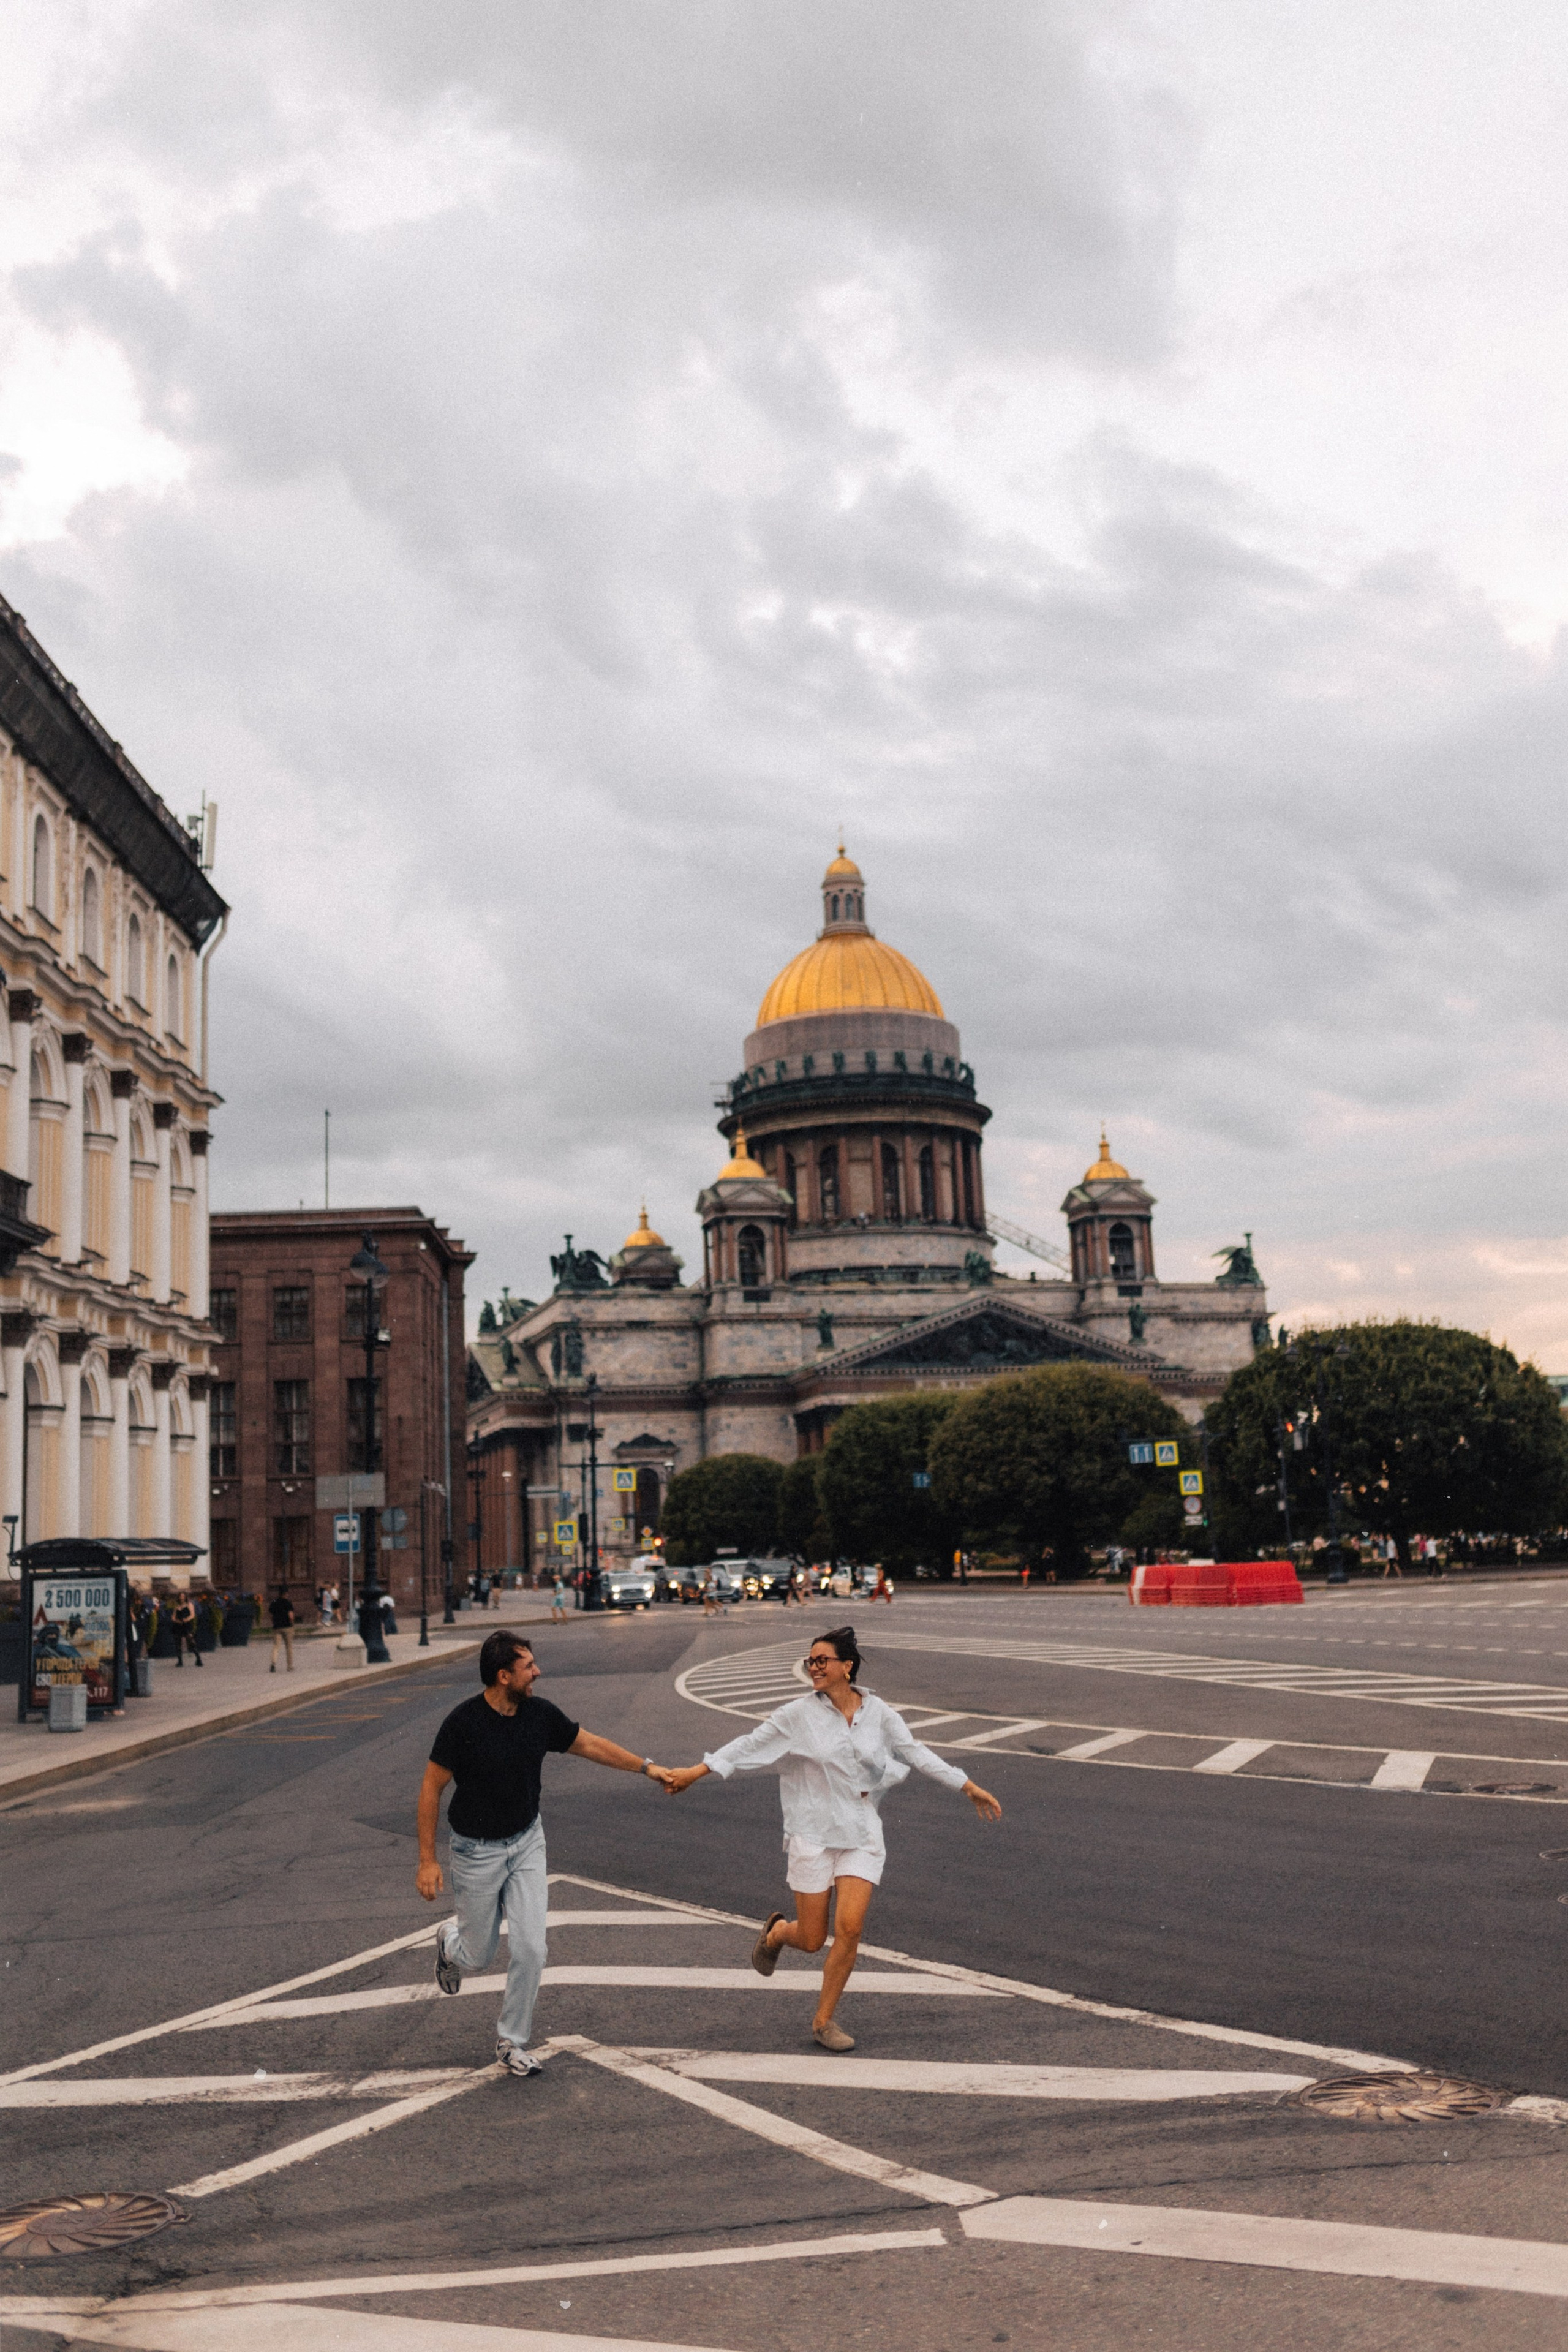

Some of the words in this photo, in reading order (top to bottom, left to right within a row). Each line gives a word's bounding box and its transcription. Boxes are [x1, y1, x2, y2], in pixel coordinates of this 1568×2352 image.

[45, 1590, 52, 1608] 2
[56, 1589, 81, 1608] 500
[86, 1588, 110, 1607] 000
